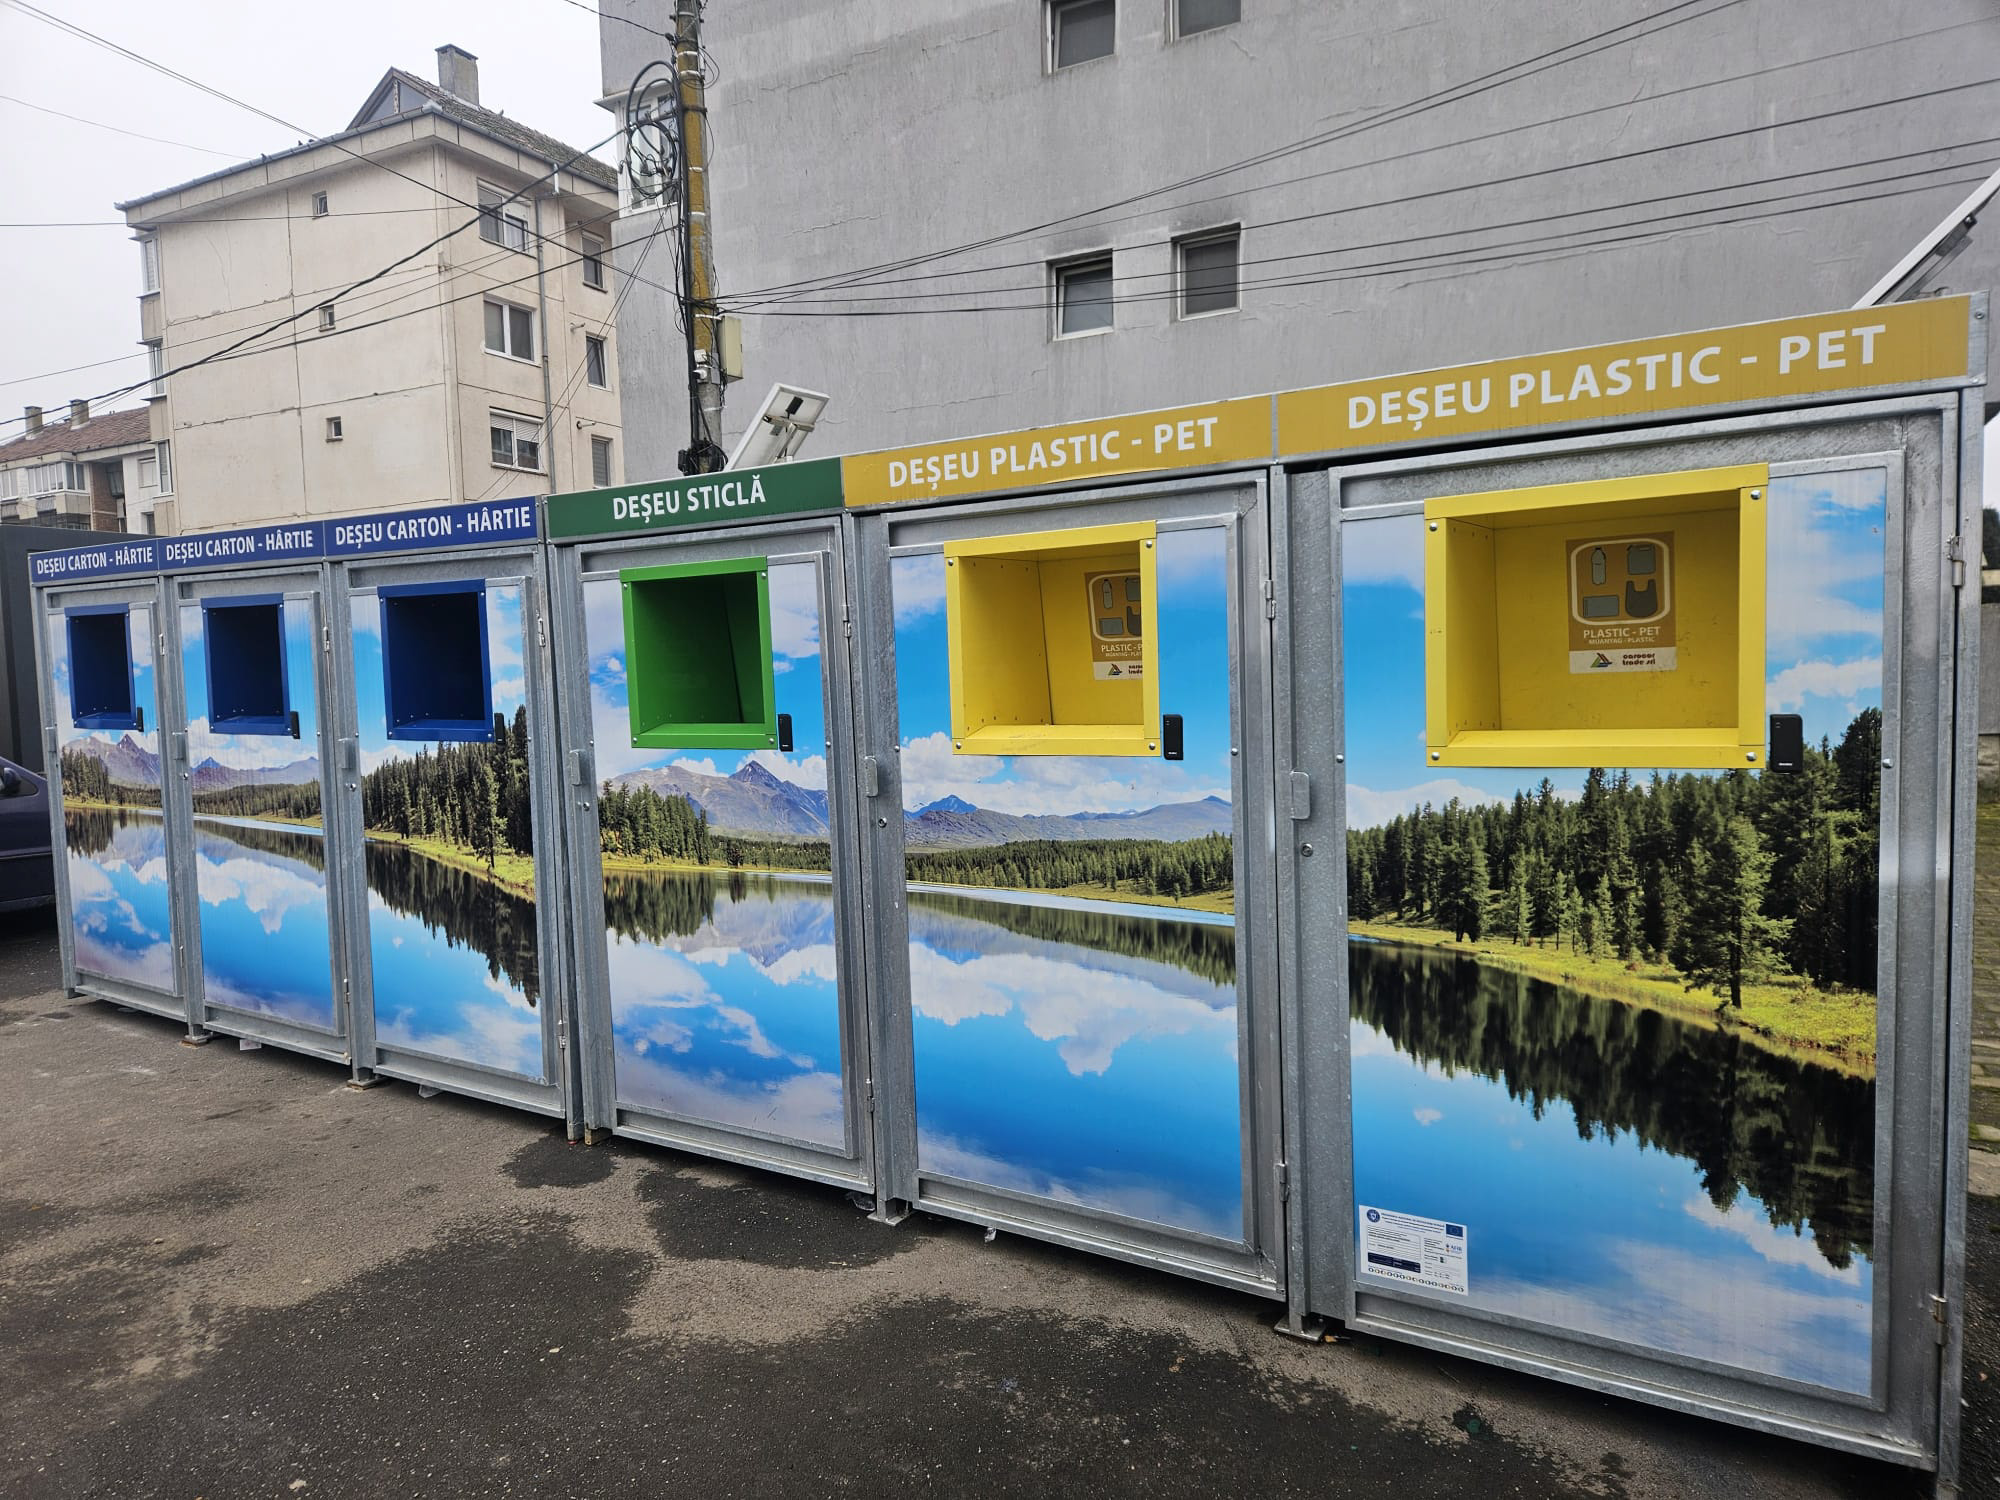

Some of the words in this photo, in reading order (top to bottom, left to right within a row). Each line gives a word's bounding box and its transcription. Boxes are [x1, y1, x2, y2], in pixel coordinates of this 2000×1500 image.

[1348, 379, 1490, 431] DEȘEU
[1509, 346, 1721, 408] PLASTIC
[1740, 355, 1758, 365] -
[1778, 325, 1887, 374] PET
[889, 451, 980, 490] DEȘEU
[990, 431, 1120, 475] PLASTIC
[1154, 417, 1218, 453] PET
[613, 489, 680, 523] DEȘEU
[687, 474, 766, 512] STICLĂ
[166, 541, 202, 563] DEȘEU
[205, 535, 255, 557] CARTON
[265, 529, 313, 550] HÂRTIE
[335, 521, 382, 549] DEȘEU
[386, 514, 452, 540] CARTON
[467, 506, 531, 533] HÂRTIE
[67, 551, 107, 571] CARTON
[115, 546, 153, 565] HÂRTIE
[1101, 643, 1133, 652] PLASTIC
[1583, 627, 1630, 639] PLASTIC
[1639, 625, 1661, 636] PET
